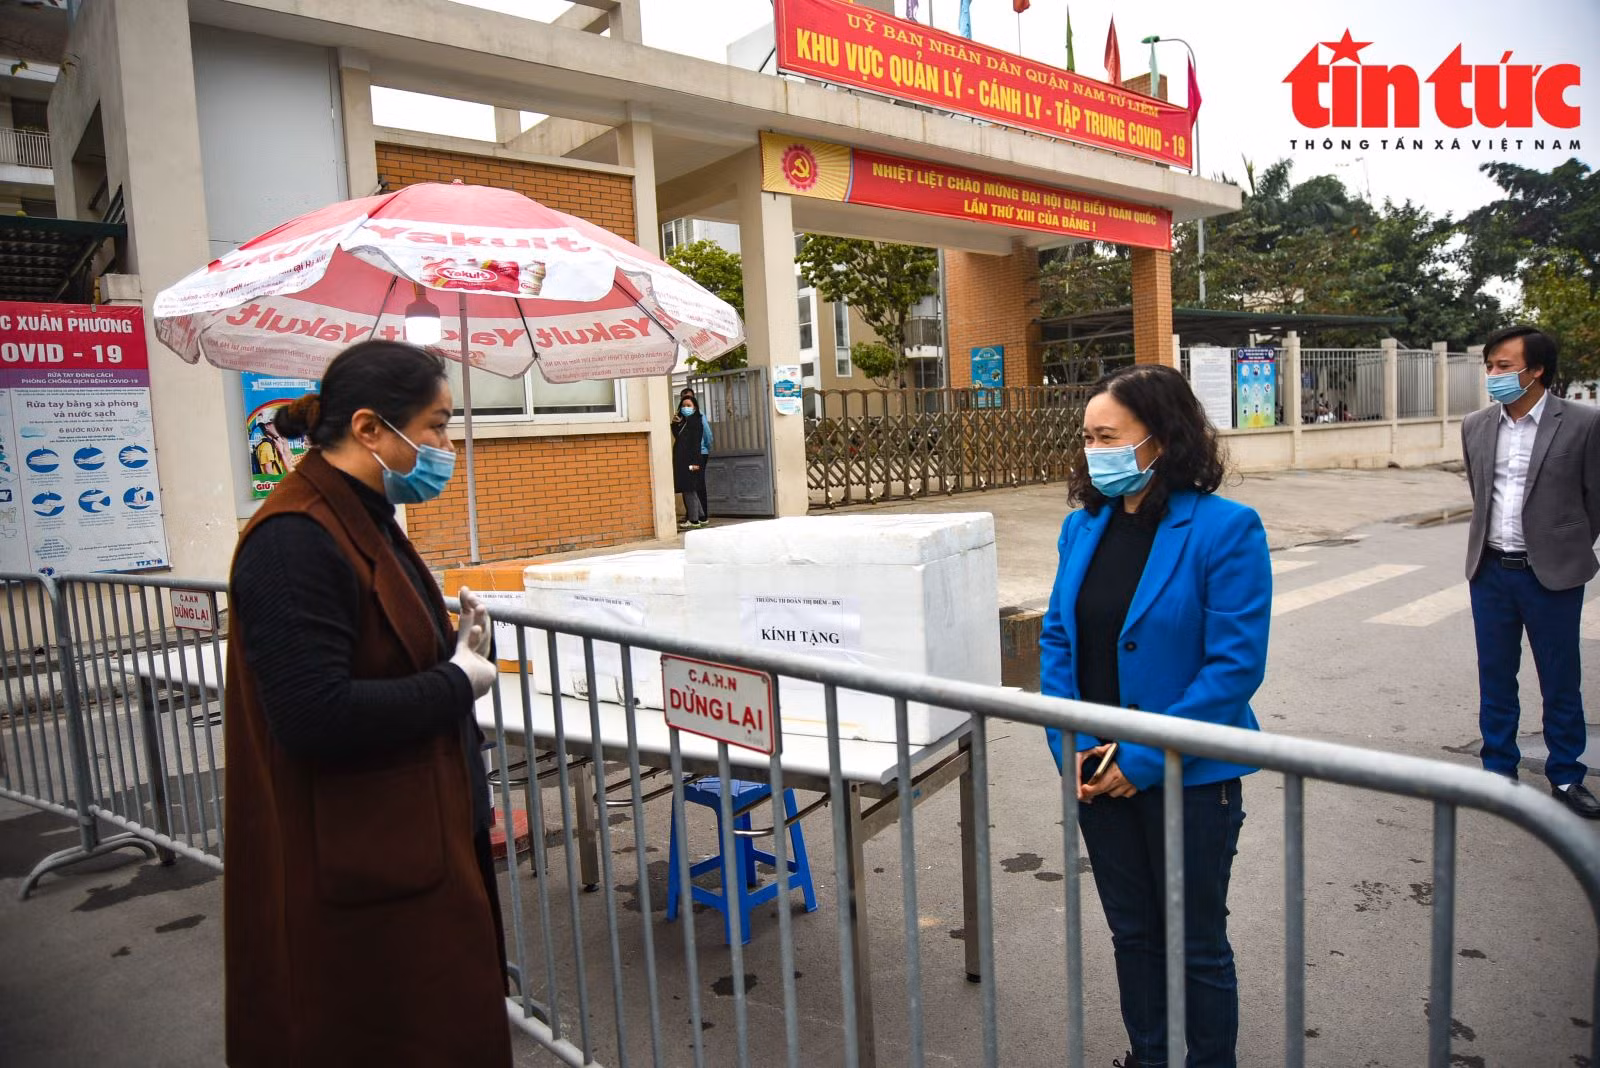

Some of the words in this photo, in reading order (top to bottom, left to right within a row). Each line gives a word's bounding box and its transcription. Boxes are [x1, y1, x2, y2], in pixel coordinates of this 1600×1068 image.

[883, 24, 923, 48] BAN
[929, 38, 981, 65] NHÂN
[986, 55, 1021, 77] DÂN
[1025, 68, 1069, 92] QUẬN
[1073, 83, 1105, 101] NAM
[796, 27, 839, 67] KHU
[845, 41, 884, 81] VỰC
[889, 51, 939, 94] QUẢN
[943, 67, 963, 99] LÝ
[979, 77, 1022, 116] CÁNH
[1025, 92, 1042, 120] LY
[1055, 100, 1080, 133] TẬP
[1084, 109, 1125, 142] TRUNG
[1128, 121, 1162, 152] COVID
[1172, 134, 1185, 158] 19
[872, 162, 914, 183] NHIỆT
[917, 170, 944, 188] LIỆT
[947, 176, 980, 194] CHÀO
[984, 182, 1019, 201] MỪNG
[1022, 190, 1040, 205] ĐẠI
[1043, 193, 1061, 210] HỘI
[1064, 198, 1080, 214] ĐẠI
[1108, 205, 1131, 220] TOÀN
[1133, 210, 1157, 225] QUỐC
[991, 203, 1014, 219] THỨ
[1016, 207, 1035, 223] XIII
[1038, 210, 1059, 227] CỦA
[1062, 214, 1090, 231] ĐẢNG
[371, 225, 591, 253] Yakult
[445, 269, 489, 279] Yakult
[17, 314, 63, 332] XUÂN
[67, 317, 133, 334] PHƯƠNG
[0, 342, 64, 363] OVID
[91, 344, 123, 364] 19
[27, 400, 45, 408] Rửa
[48, 401, 64, 410] tay
[67, 400, 92, 409] bằng
[94, 400, 106, 408] xà
[107, 400, 139, 408] phòng
[53, 410, 66, 418] và
[68, 410, 92, 418] nước
[94, 410, 116, 419] sạch
[195, 608, 209, 623] LẠI
[761, 626, 796, 642] KÍNH
[800, 629, 840, 646] TẶNG
[688, 669, 737, 692] C.A.H.N
[670, 684, 723, 720] DỪNG
[727, 702, 763, 734] LẠI
